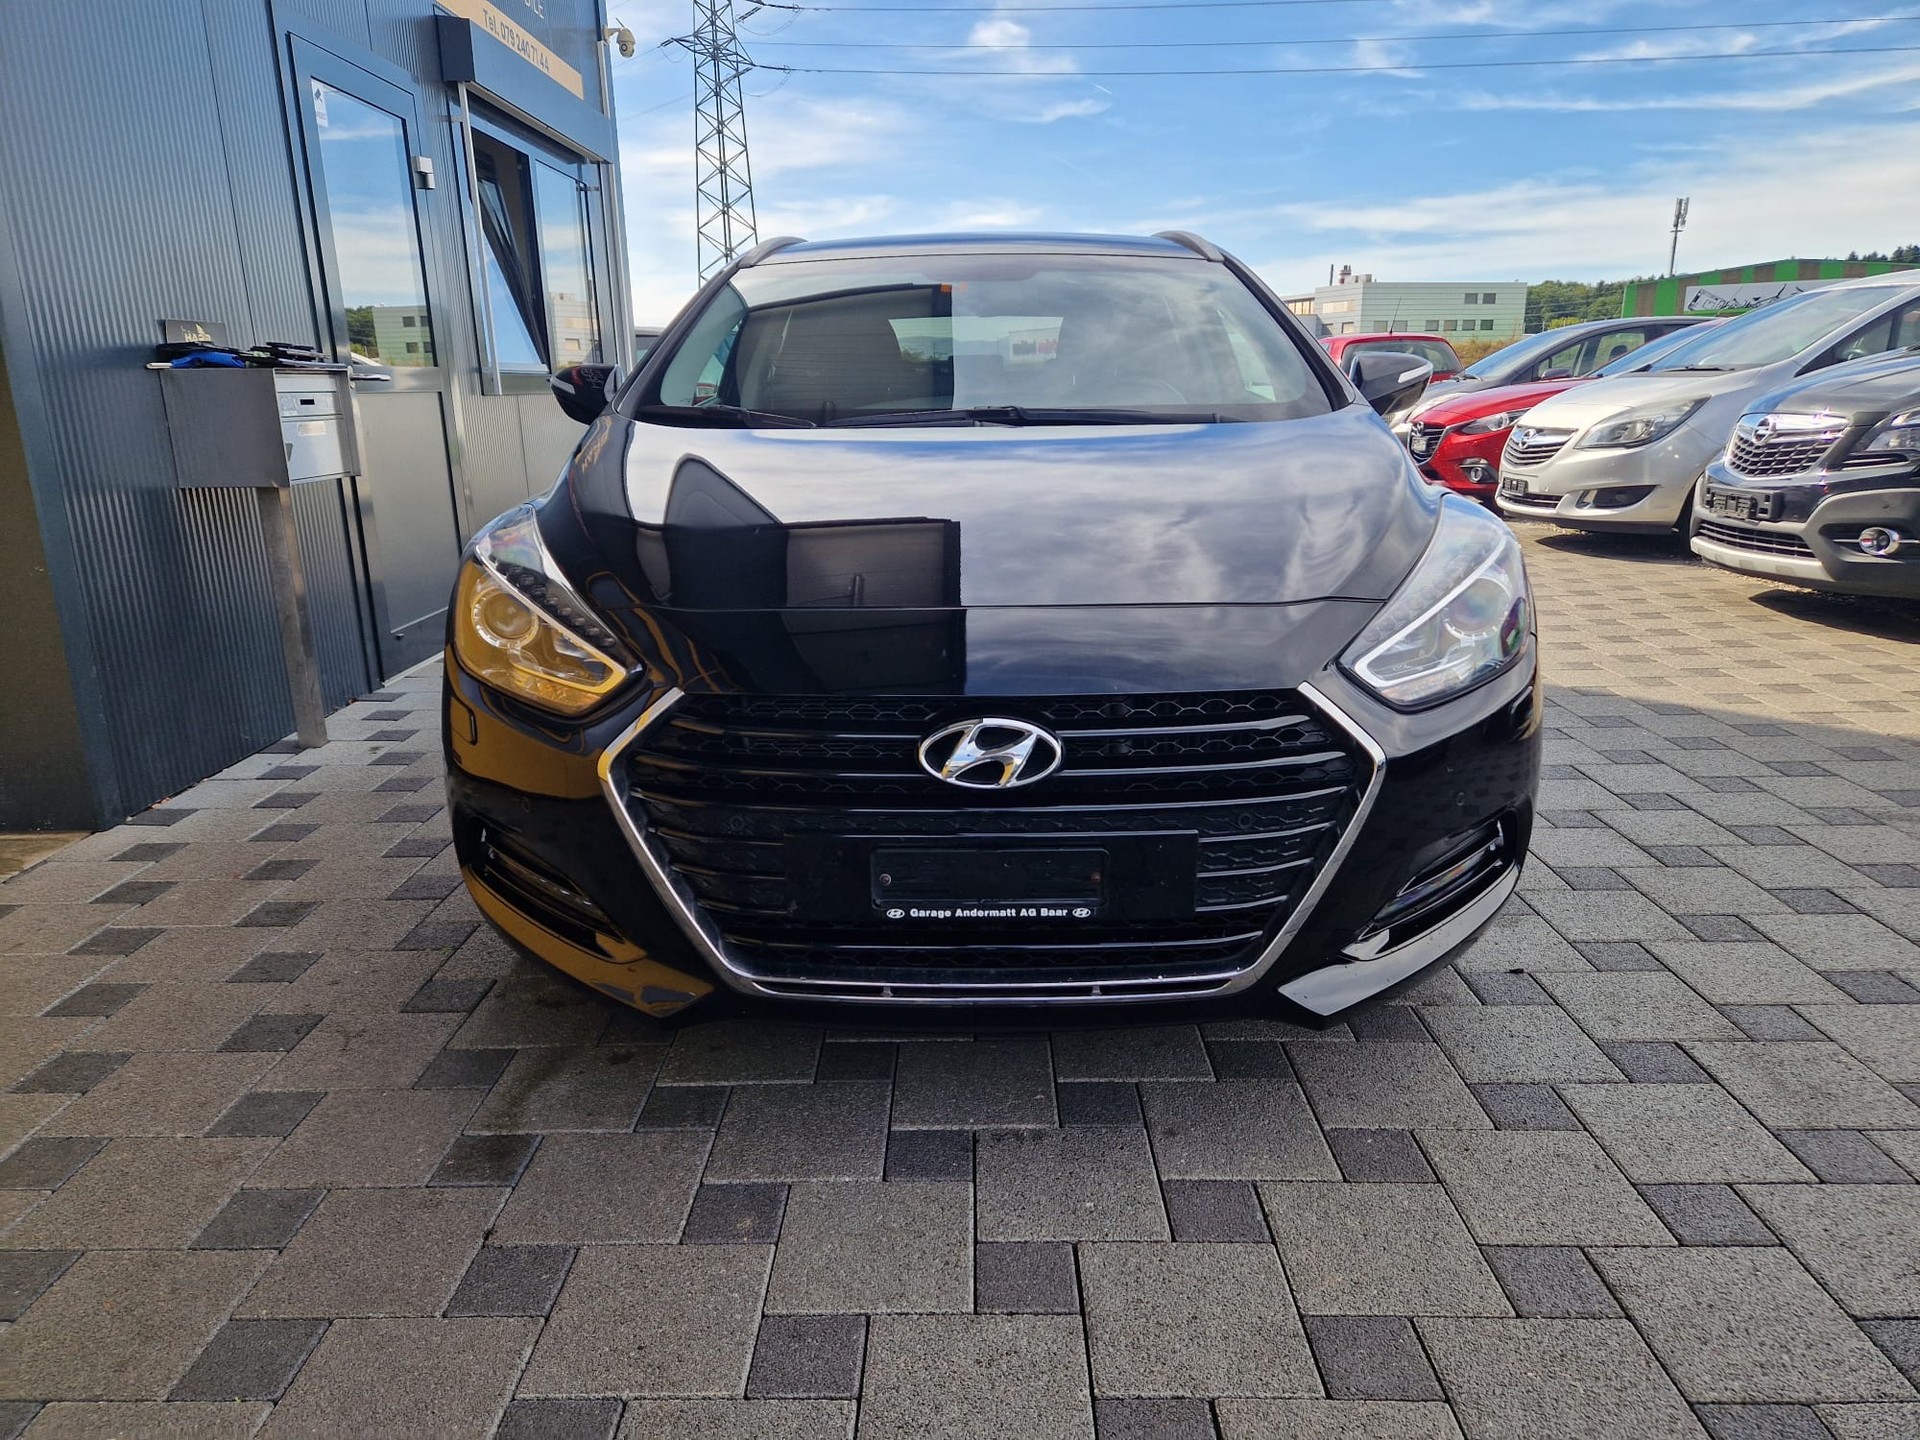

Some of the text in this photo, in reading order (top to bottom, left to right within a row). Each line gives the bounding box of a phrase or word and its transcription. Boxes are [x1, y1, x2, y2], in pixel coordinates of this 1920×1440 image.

[483, 8, 500, 36] Tel.
[500, 21, 515, 47] 079
[516, 33, 530, 60] 240
[539, 52, 550, 72] 44
[910, 907, 1068, 918] Garage Andermatt AG Baar
